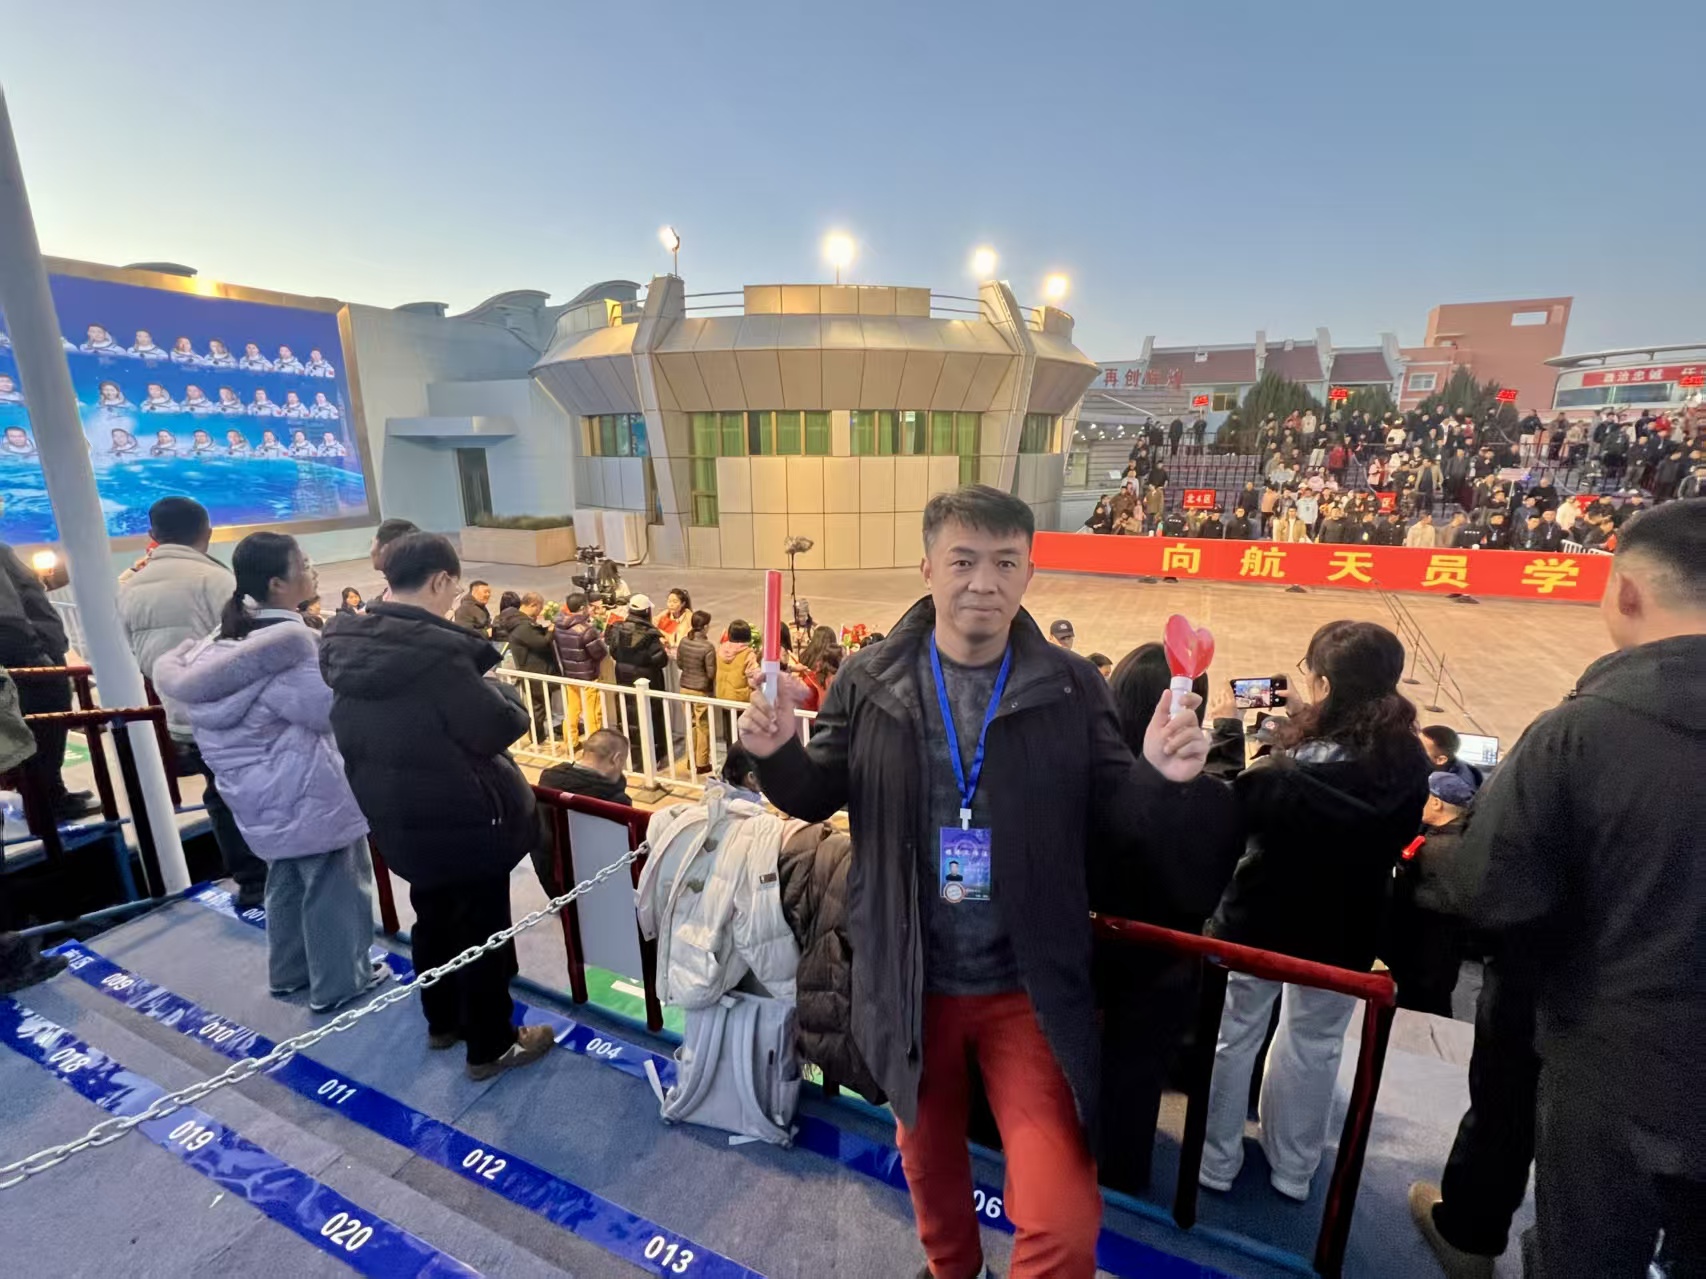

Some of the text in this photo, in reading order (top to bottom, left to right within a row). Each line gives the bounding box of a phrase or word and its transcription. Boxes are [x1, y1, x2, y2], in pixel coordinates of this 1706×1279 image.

[1161, 543, 1580, 593] 向航天员学
[101, 973, 134, 990] 009
[199, 1021, 235, 1042] 010
[49, 1047, 91, 1073] 018
[586, 1037, 623, 1059] 004
[317, 1079, 357, 1104] 011
[168, 1120, 215, 1151] 019
[462, 1148, 507, 1180] 012
[321, 1212, 373, 1251] 020
[644, 1235, 694, 1272] 013
